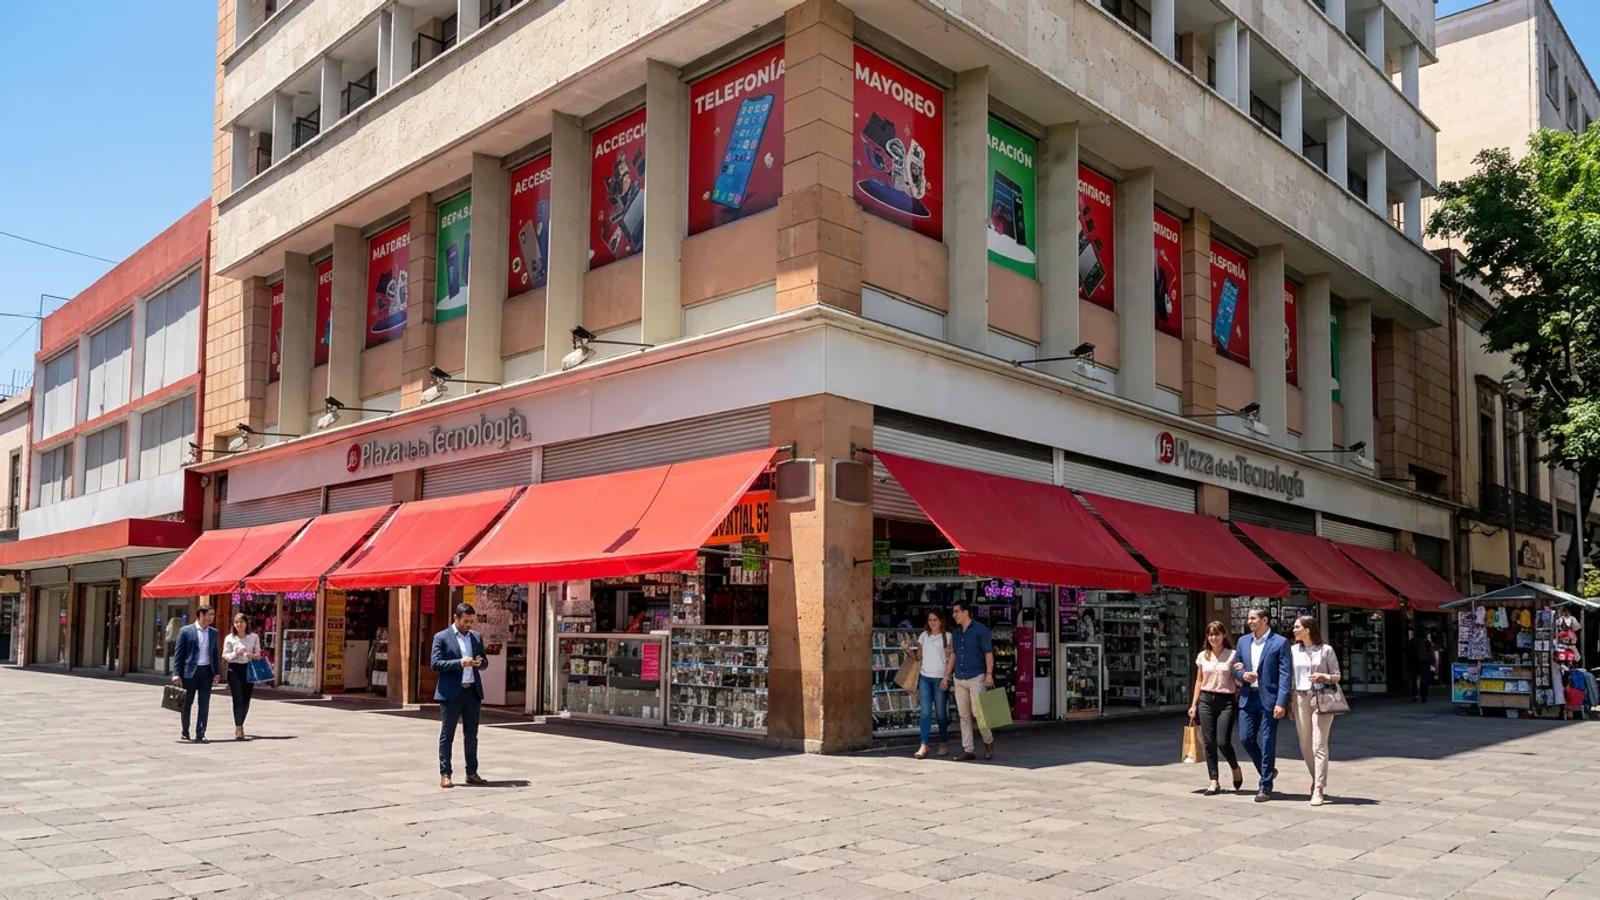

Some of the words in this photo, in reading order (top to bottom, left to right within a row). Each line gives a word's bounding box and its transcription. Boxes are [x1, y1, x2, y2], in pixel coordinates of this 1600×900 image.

[694, 57, 785, 114] TELEFONÍA
[855, 61, 936, 118] MAYOREO
[362, 441, 402, 467] Plaza
[428, 408, 527, 453] Tecnología
